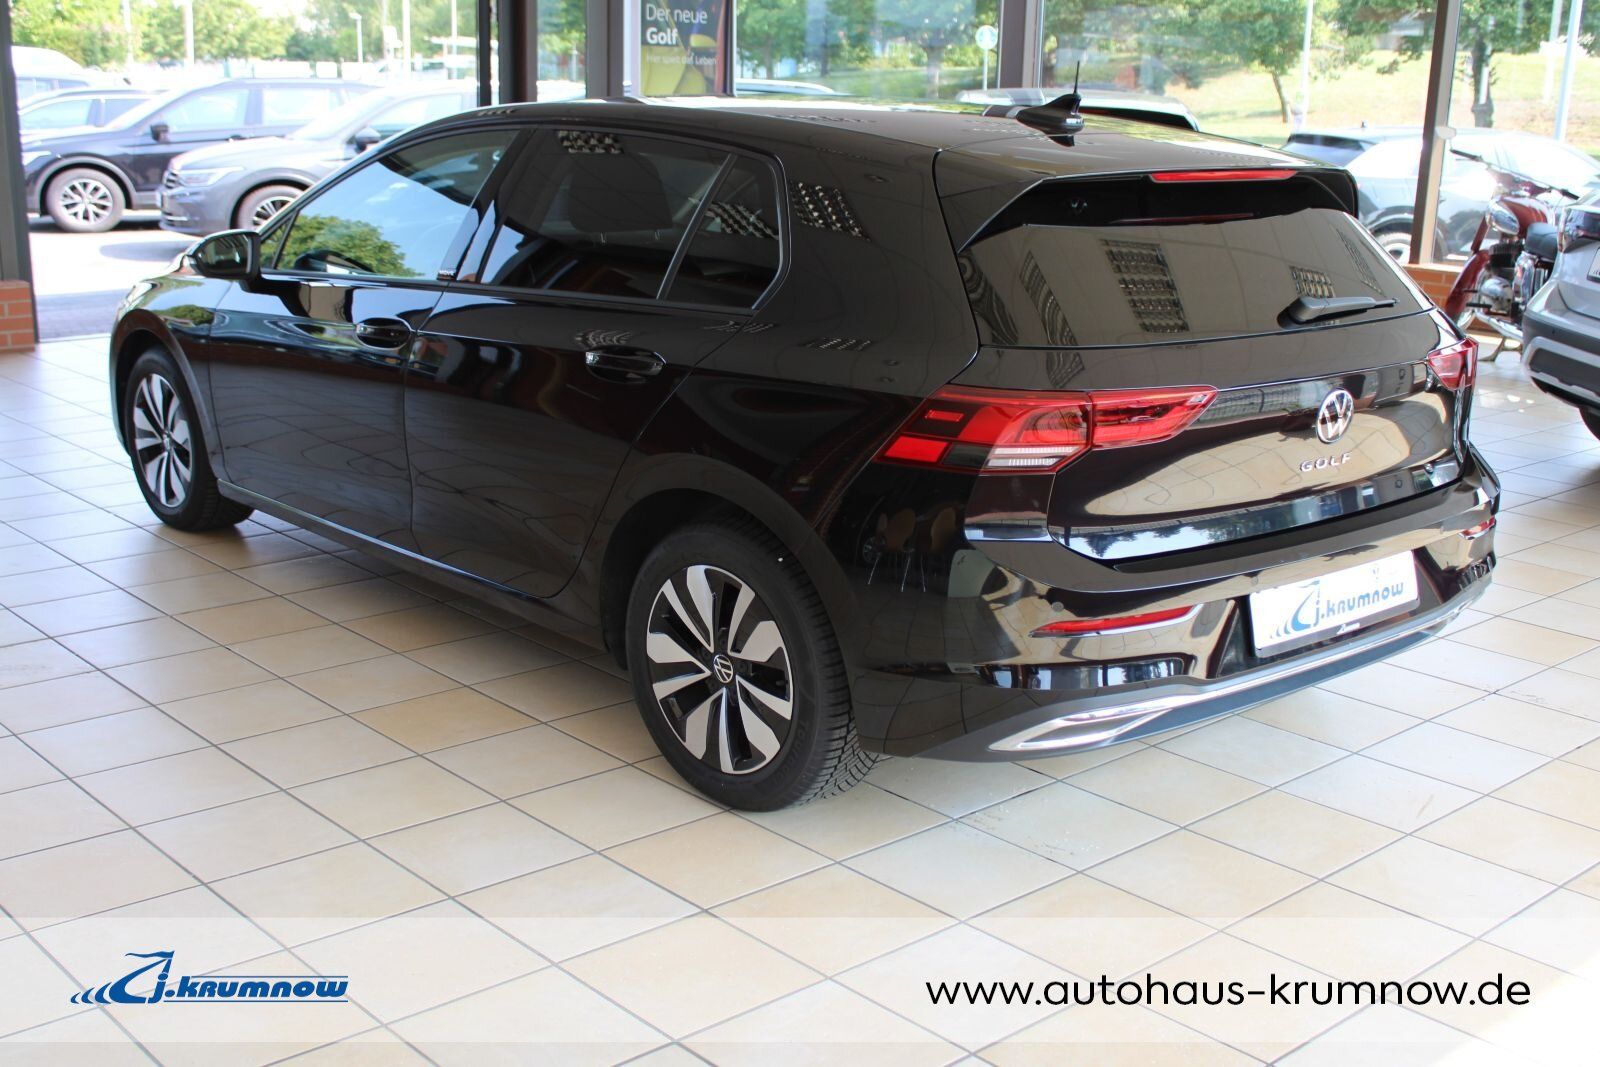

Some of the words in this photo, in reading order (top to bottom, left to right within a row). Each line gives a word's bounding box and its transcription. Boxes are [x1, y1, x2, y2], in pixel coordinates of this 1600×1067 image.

[646, 3, 671, 22] Der
[674, 9, 708, 24] neue
[646, 27, 678, 45] Golf
[1300, 452, 1352, 472] GOLF
